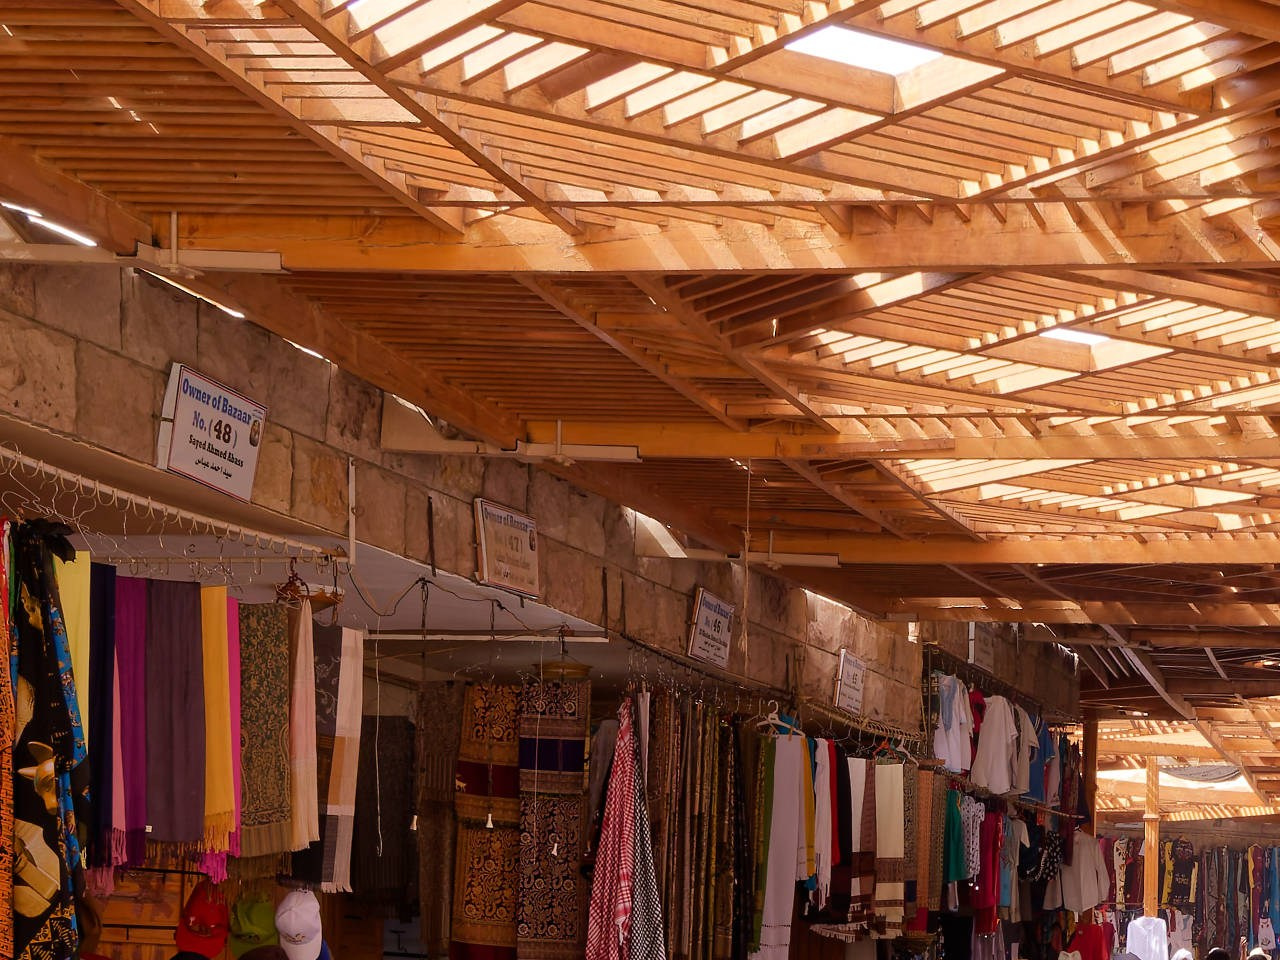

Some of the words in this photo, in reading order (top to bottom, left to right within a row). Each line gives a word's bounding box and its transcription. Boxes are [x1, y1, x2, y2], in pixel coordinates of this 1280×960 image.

[182, 378, 210, 405] Owner
[212, 395, 221, 410] of
[222, 397, 251, 425] Bazaar
[192, 410, 207, 431] No.
[189, 434, 207, 451] Sayed
[207, 444, 227, 460] Ahmed
